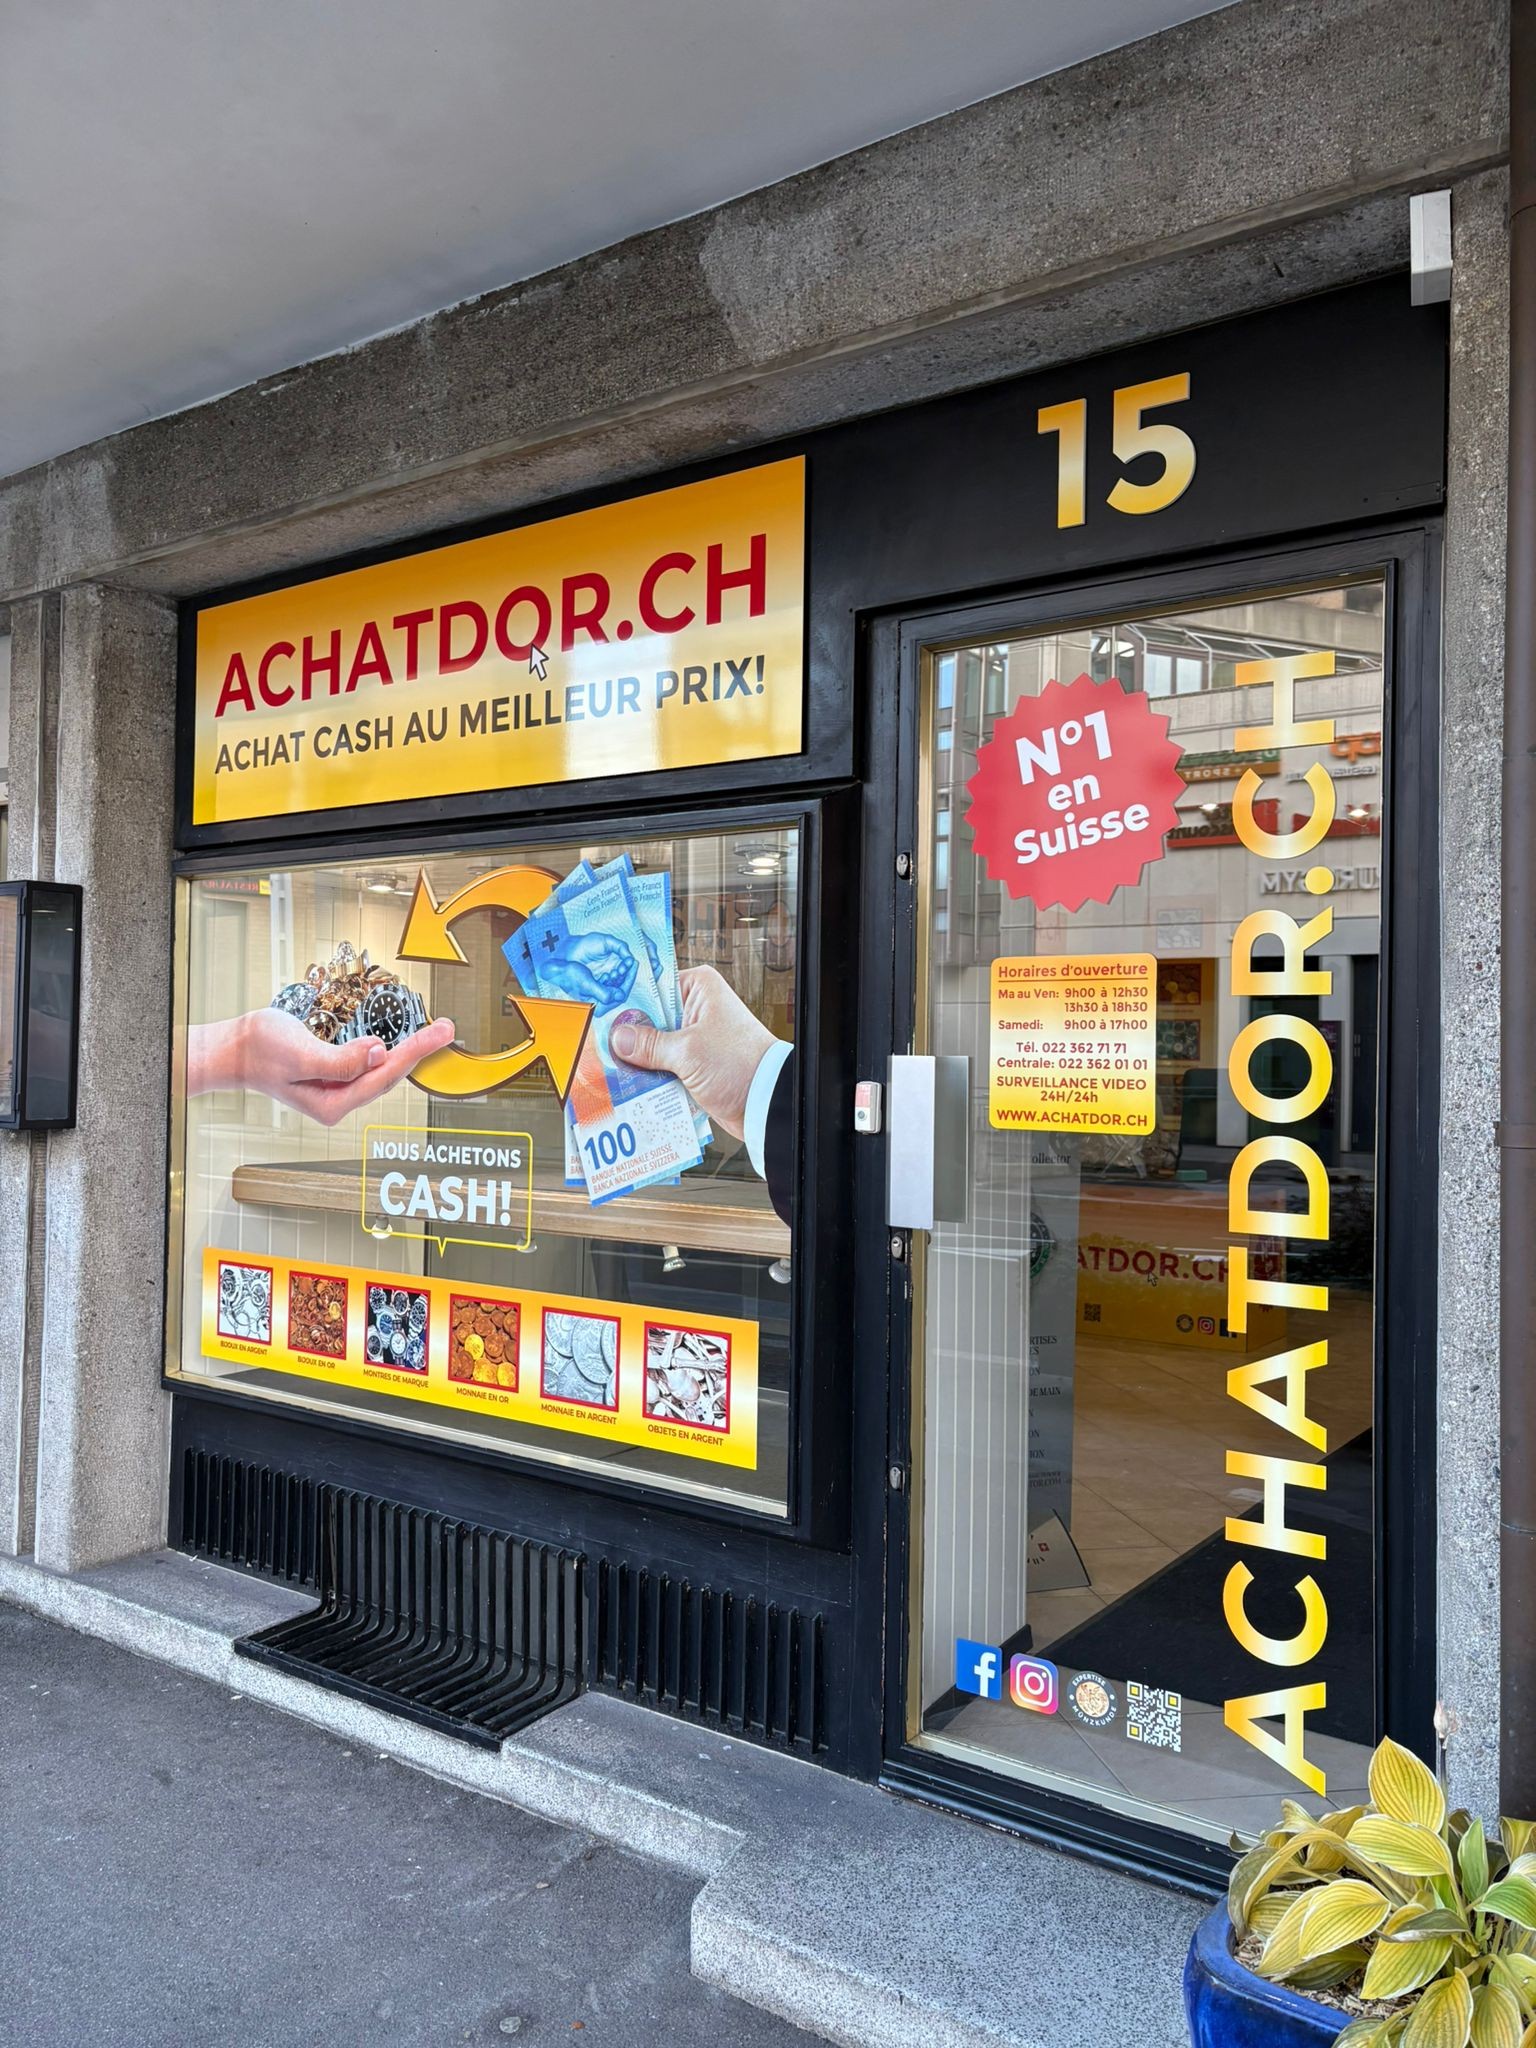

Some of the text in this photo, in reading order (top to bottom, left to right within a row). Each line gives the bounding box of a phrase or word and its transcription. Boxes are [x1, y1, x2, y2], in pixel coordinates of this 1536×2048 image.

[1038, 372, 1196, 529] 15
[215, 533, 766, 718] ACHATDOR.CH
[215, 655, 765, 774] ACHAT CASH AU MEILLEUR PRIX!
[1048, 774, 1101, 811] en
[1014, 803, 1149, 864] Suisse
[998, 964, 1057, 978] Horaires
[998, 986, 1148, 999] Ma au Ven: 9h00 à 12h30
[1065, 1002, 1098, 1013] 13h30
[1102, 1001, 1109, 1013] à
[1112, 1001, 1148, 1013] 18h30
[998, 1018, 1148, 1030] Samedi: 9h00 à 17h00
[1016, 1041, 1127, 1054] Tél. 022 362 71 71
[997, 1057, 1148, 1070] Centrale: 022 362 01 01
[997, 1075, 1147, 1090] SURVEILLANCE VIDEO
[1041, 1090, 1098, 1103] 24H/24h
[997, 1109, 1148, 1127] WWW.ACHATDOR.CH
[373, 1141, 521, 1168] NOUS ACHETONS
[584, 1122, 636, 1170] 100
[380, 1171, 512, 1227] CASH!
[1223, 651, 1336, 1798] ACHATDOR.CH
[318, 1359, 326, 1368] EN
[326, 1360, 336, 1369] OR
[363, 1368, 429, 1388] MONTRES DE MARQUE
[456, 1387, 509, 1404] MONNAIE EN OR
[540, 1403, 617, 1425] MONNAIE EN ARGENT
[648, 1424, 724, 1446] OBJETS EN ARGENT
